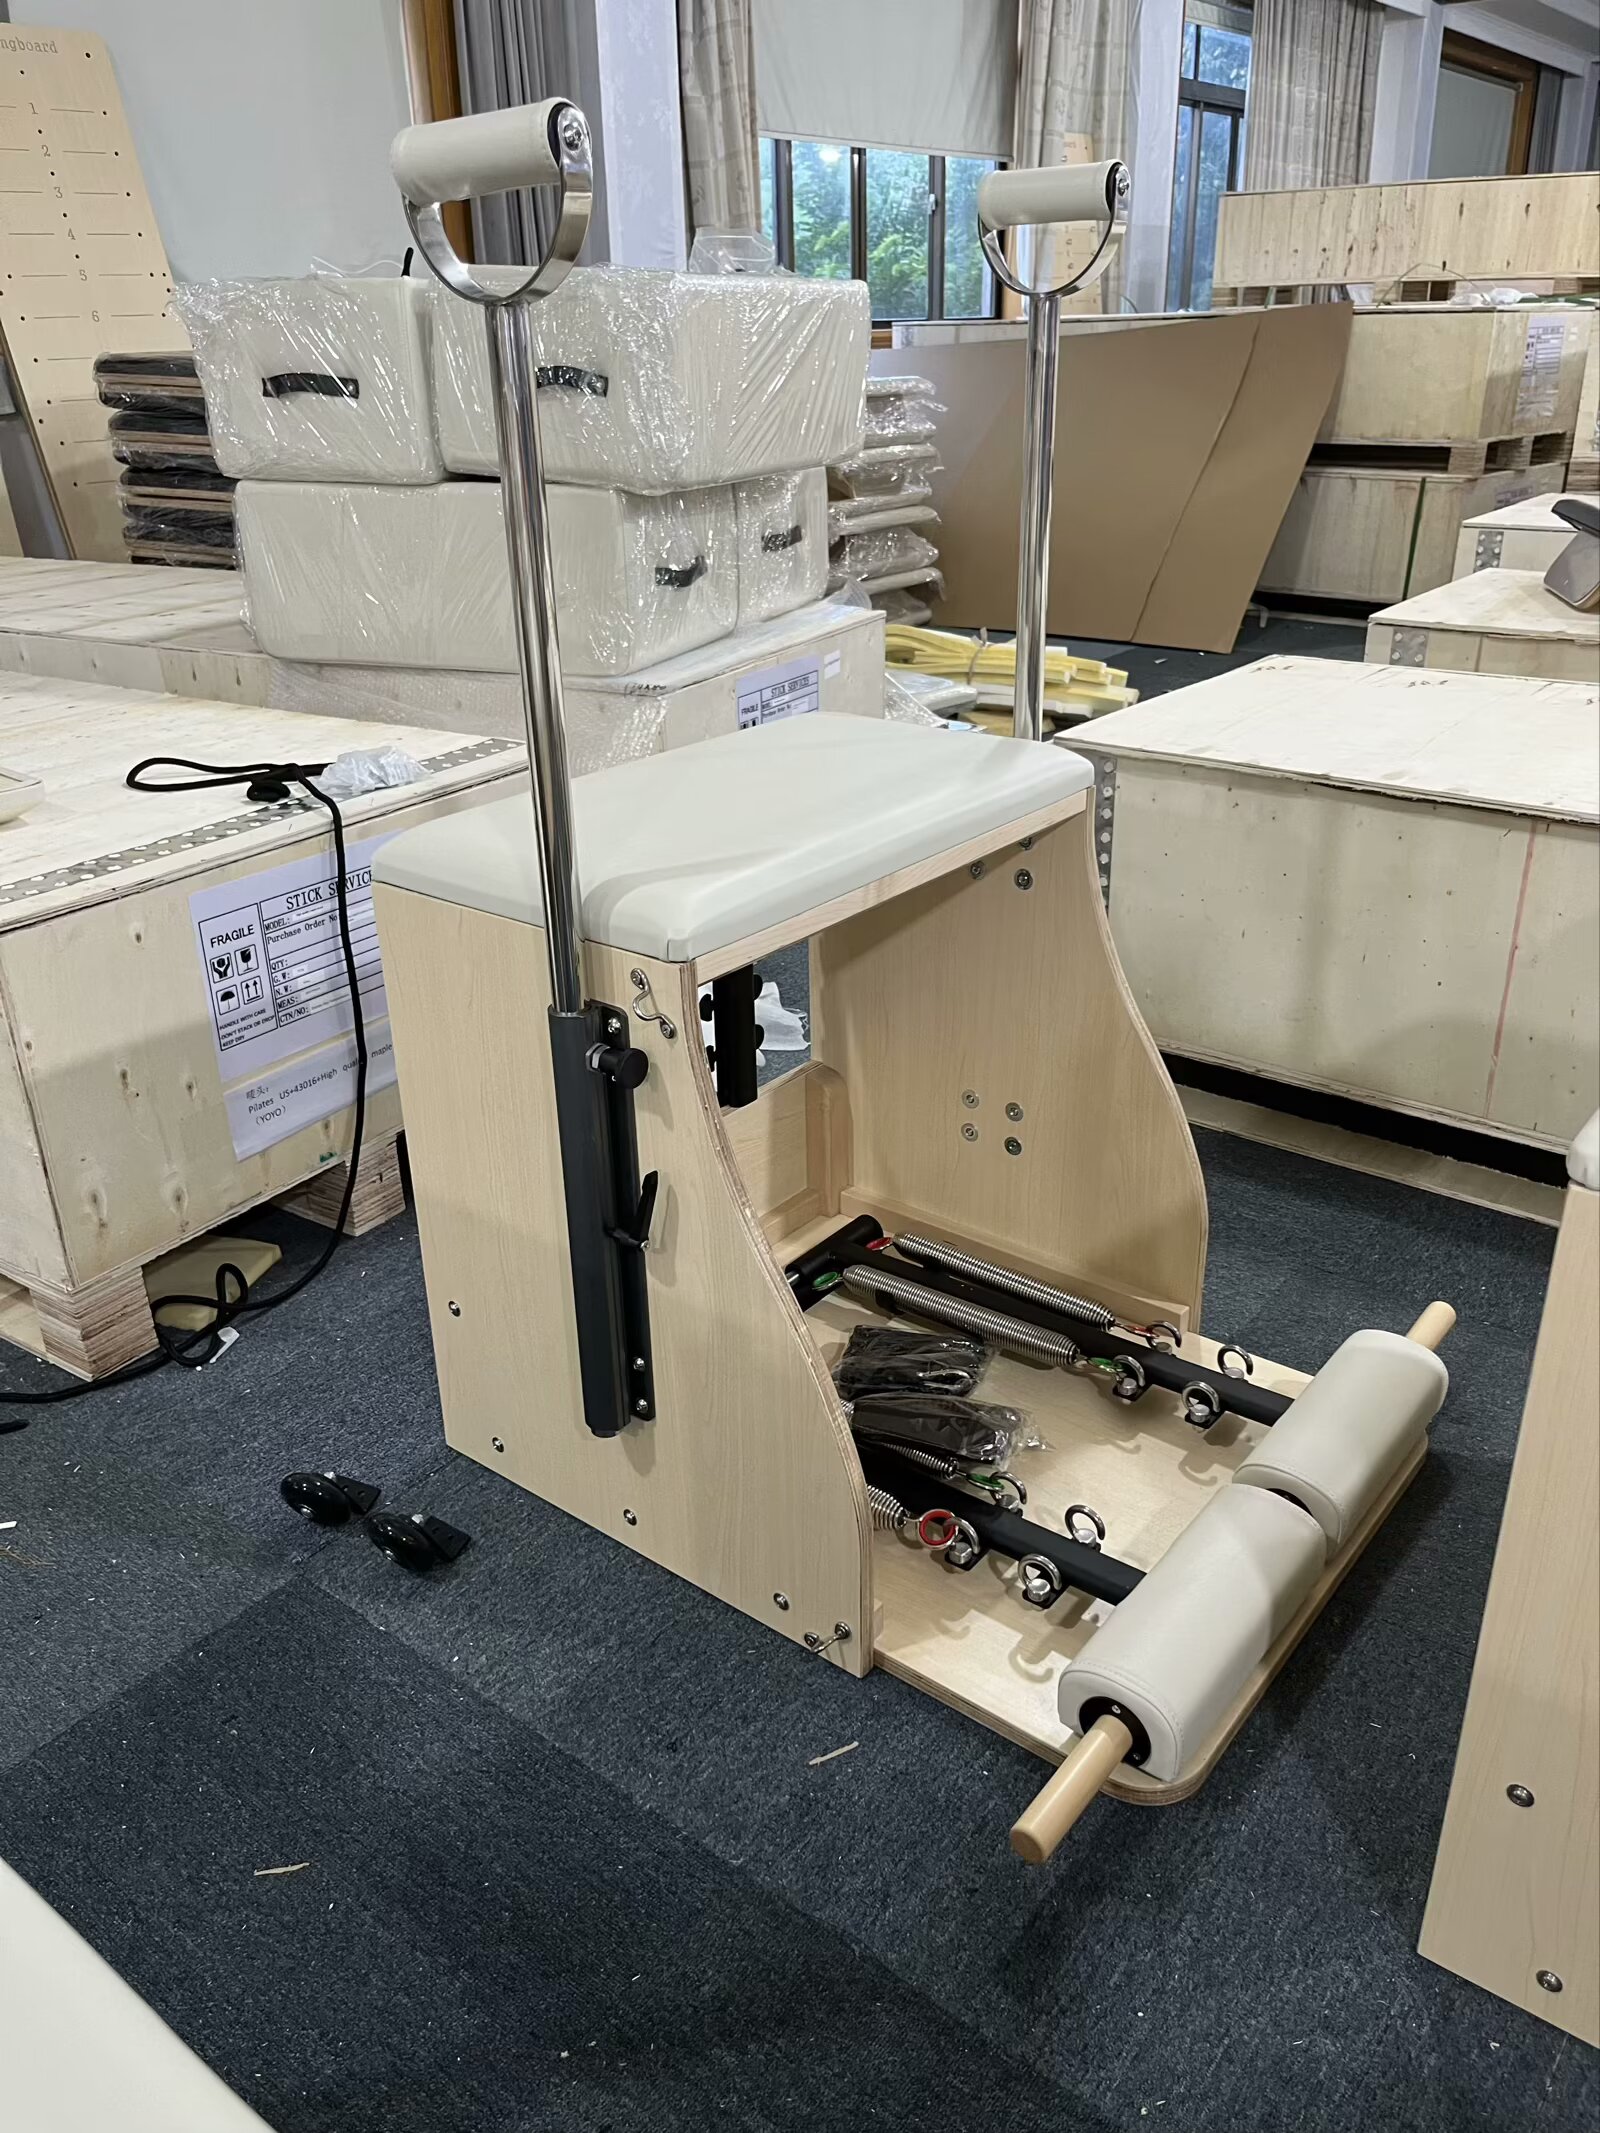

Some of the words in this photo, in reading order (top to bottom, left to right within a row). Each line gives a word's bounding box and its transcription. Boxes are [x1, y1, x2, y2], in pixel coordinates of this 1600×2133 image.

[29, 102, 39, 115] 1
[42, 144, 51, 157] 2
[54, 186, 64, 199] 3
[67, 228, 76, 241] 4
[79, 269, 88, 282] 5
[91, 310, 100, 323] 6
[286, 887, 323, 911] STICK
[264, 917, 291, 932] MODEL:
[210, 924, 255, 948] FRAGILE
[266, 927, 302, 945] Purchase
[304, 918, 326, 931] Order
[271, 959, 289, 971] QTY:
[280, 1006, 309, 1023] CTN/NO:
[248, 1097, 274, 1115] Pilates
[279, 1067, 338, 1101] US+43016+High
